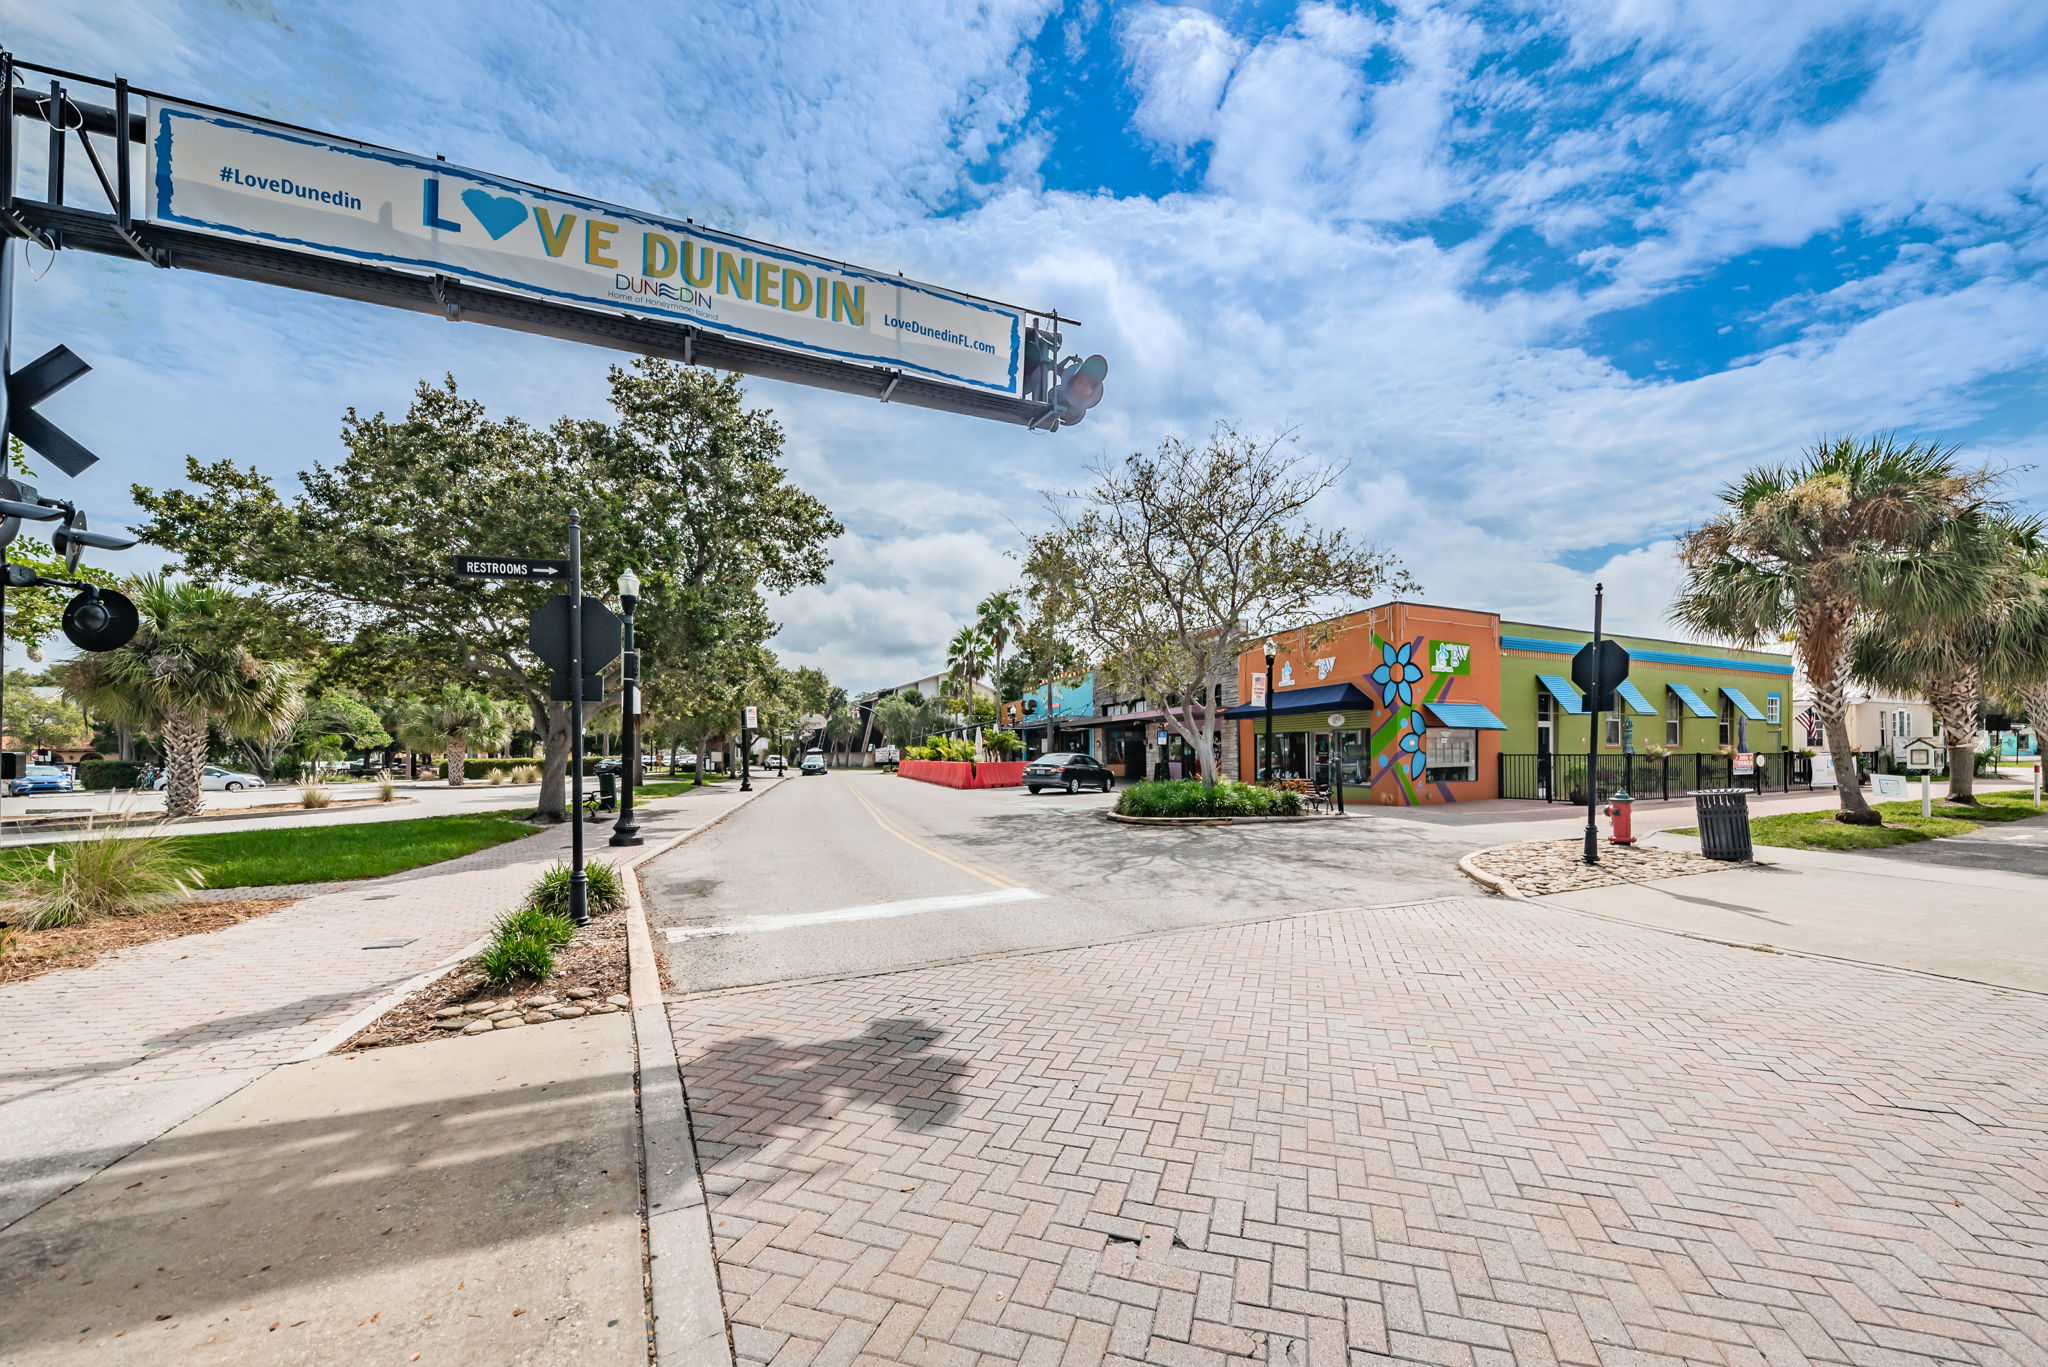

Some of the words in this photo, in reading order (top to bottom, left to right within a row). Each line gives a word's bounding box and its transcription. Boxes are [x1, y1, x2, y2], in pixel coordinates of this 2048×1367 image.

[219, 166, 362, 211] #LoveDunedin
[642, 231, 865, 326] DUNEDIN
[608, 290, 633, 301] Home
[646, 298, 693, 313] Honeymoon
[696, 309, 719, 320] Island
[884, 314, 995, 355] LoveDunedinFL.com
[466, 561, 528, 575] RESTROOMS
